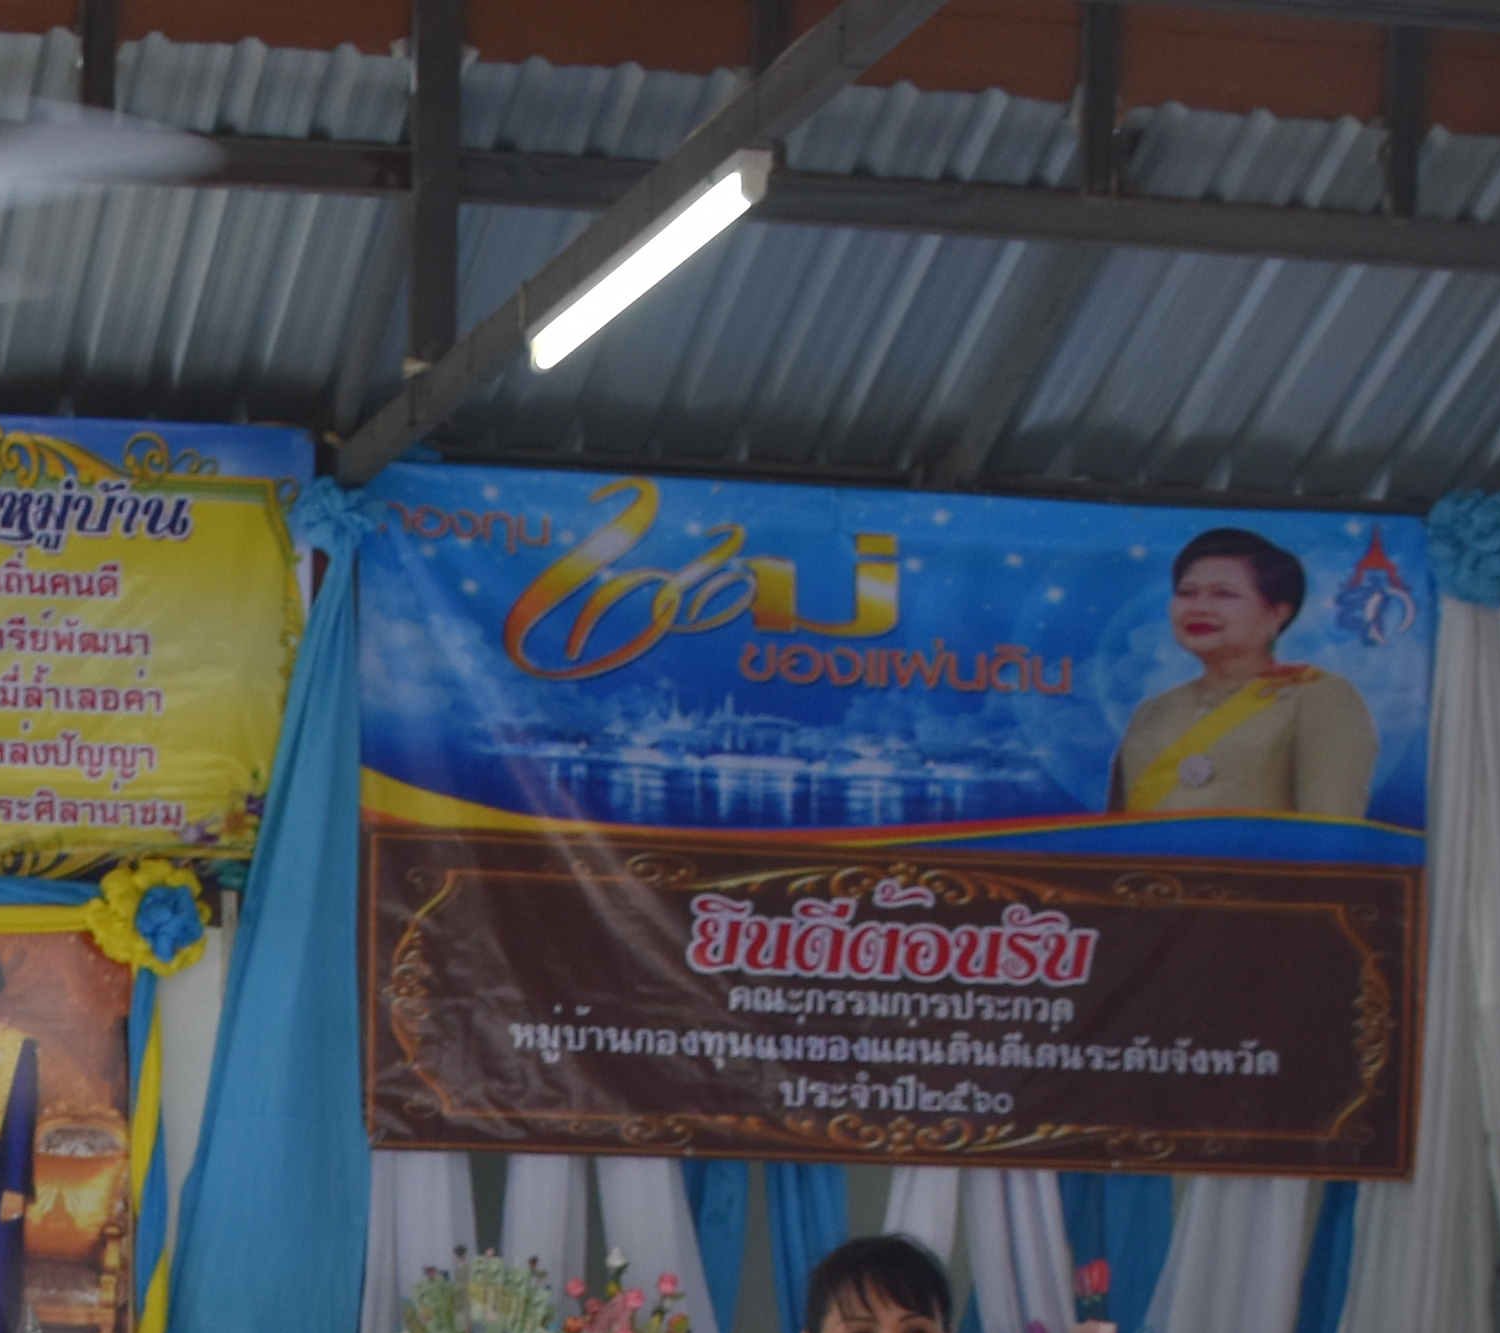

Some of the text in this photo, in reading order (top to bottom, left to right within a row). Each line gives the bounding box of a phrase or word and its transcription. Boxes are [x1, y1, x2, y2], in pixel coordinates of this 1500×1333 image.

[738, 632, 1074, 697] ของแผ่นดิน
[686, 880, 1098, 986] ยินดีต้อนรับ
[727, 983, 1074, 1024] คณะกรรมการประกวด
[507, 1003, 1280, 1078] หมู่บ้านกองทุนแม่ของแผ่นดินดีเด่นระดับจังหวัด
